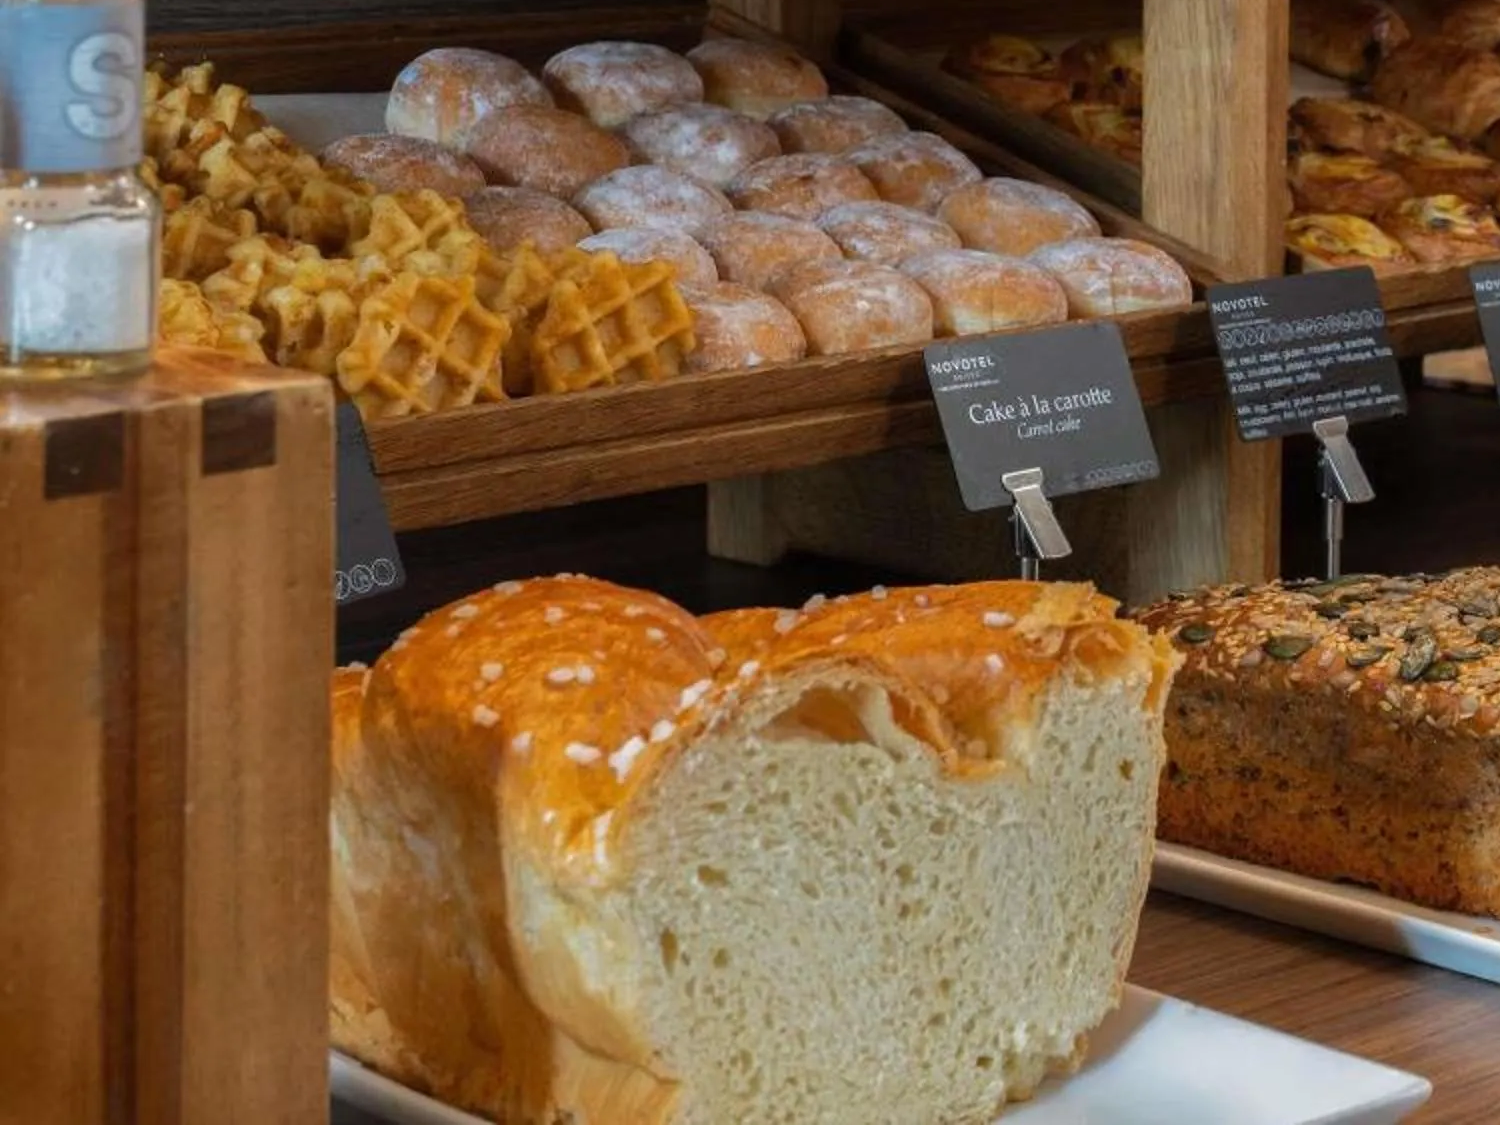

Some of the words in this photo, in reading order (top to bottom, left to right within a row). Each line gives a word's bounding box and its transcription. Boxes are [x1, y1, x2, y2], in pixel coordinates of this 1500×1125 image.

[1212, 296, 1269, 313] NOVOTEL
[931, 355, 996, 374] NOVOTEL
[969, 400, 1015, 425] Cake
[1018, 396, 1031, 418] à
[1033, 394, 1050, 414] la
[1051, 387, 1113, 412] carotte
[1055, 416, 1081, 434] cake
